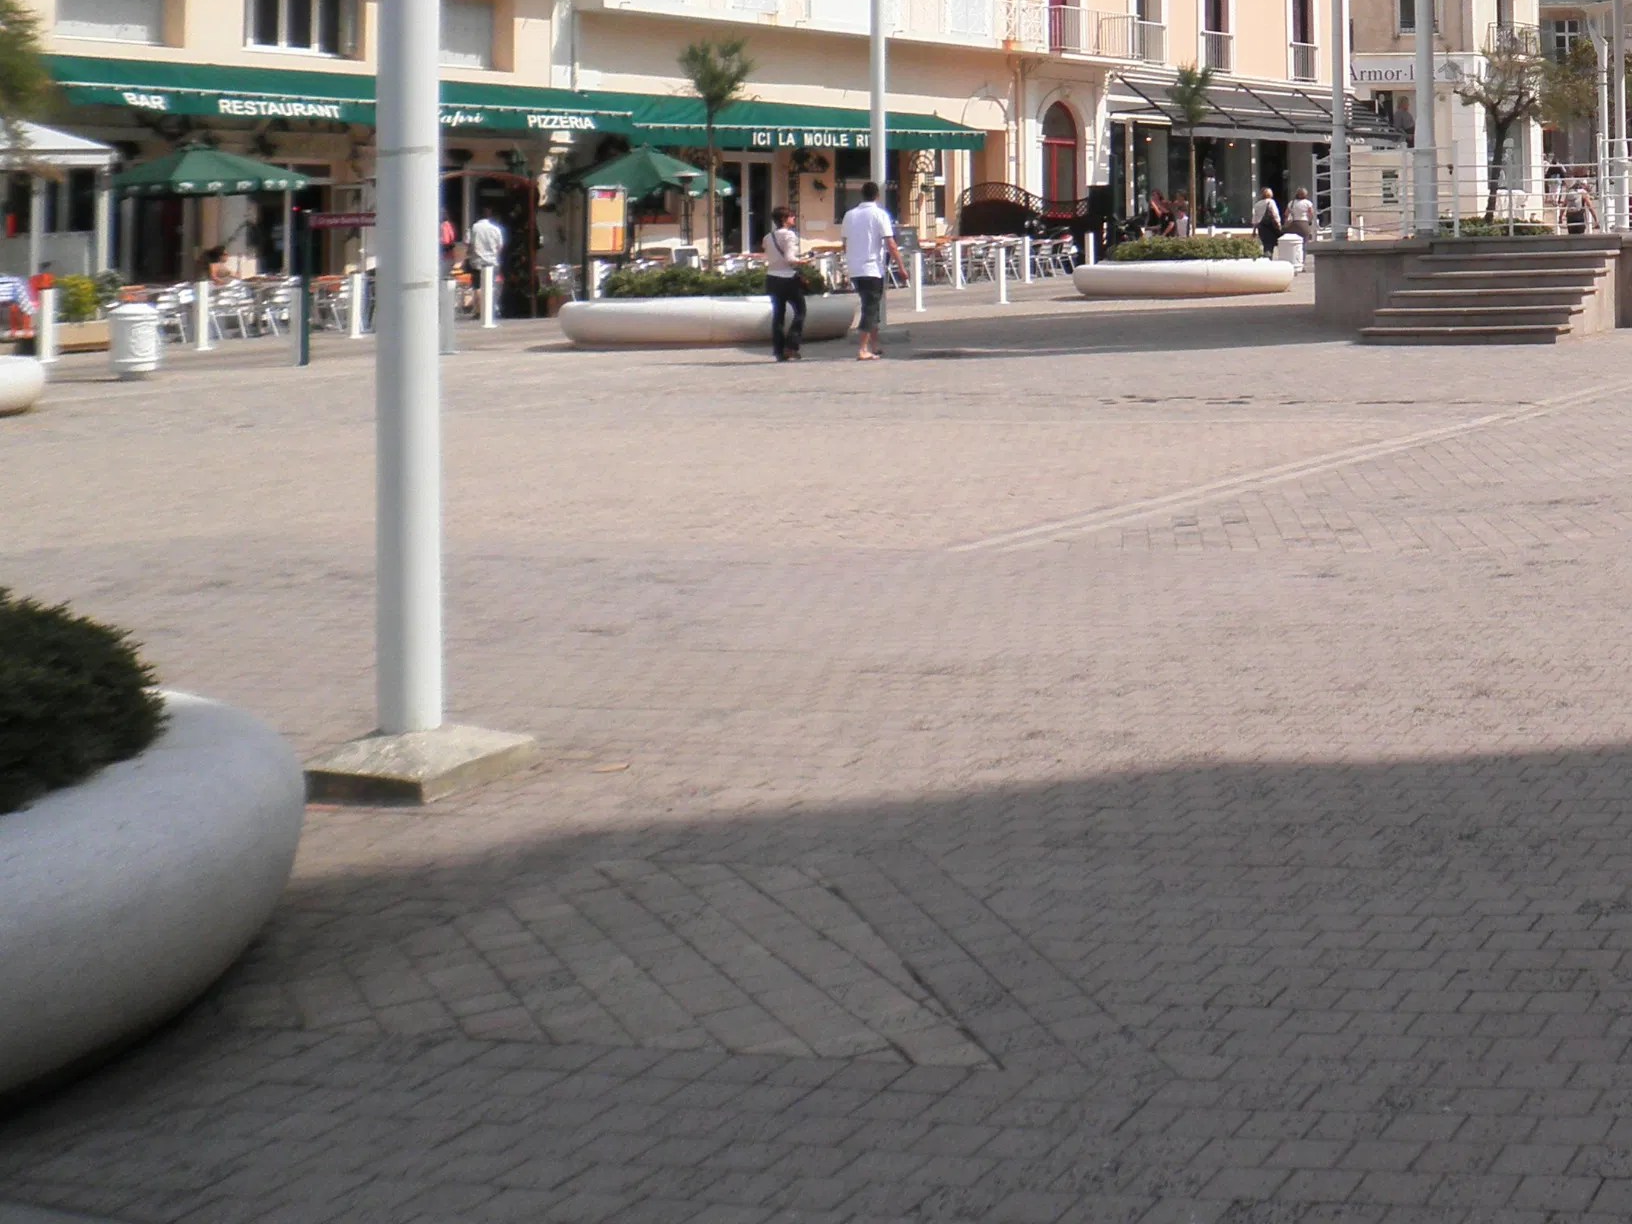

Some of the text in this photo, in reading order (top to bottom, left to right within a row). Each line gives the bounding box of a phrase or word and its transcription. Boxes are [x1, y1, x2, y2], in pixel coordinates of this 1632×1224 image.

[122, 92, 167, 110] BAR
[218, 99, 340, 119] RESTAURANT
[752, 131, 871, 147] ICI LA MOULE RI
